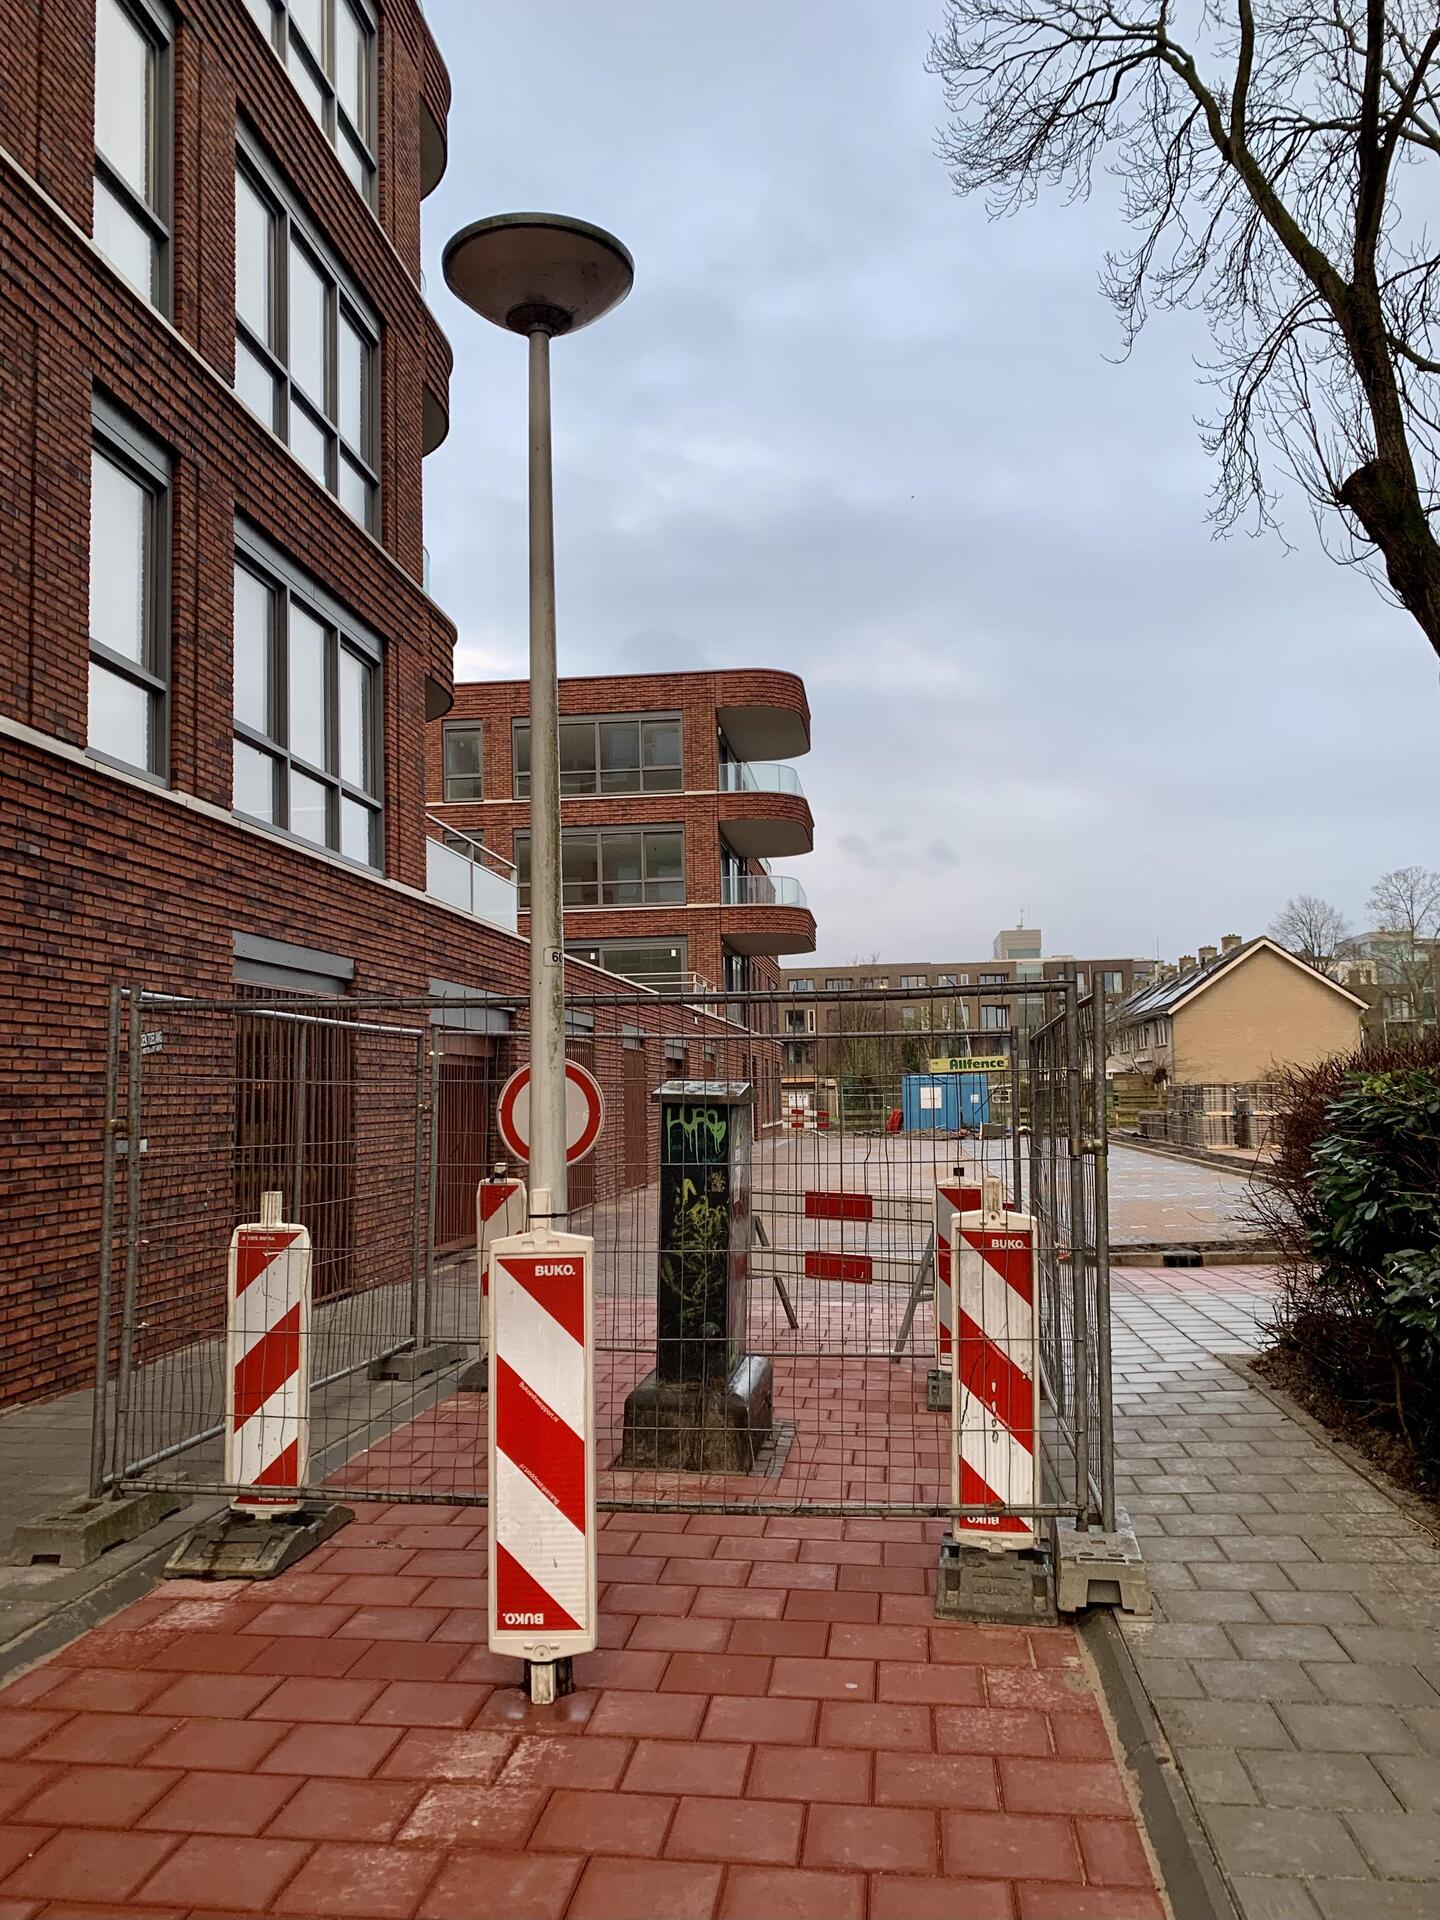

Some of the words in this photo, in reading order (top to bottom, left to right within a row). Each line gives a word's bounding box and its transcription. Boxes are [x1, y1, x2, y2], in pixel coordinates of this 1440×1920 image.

[949, 1058, 1004, 1070] Allfence
[991, 1238, 1027, 1249] BUKO.
[534, 1264, 576, 1277] BUKO.
[502, 1612, 544, 1625] BUKO.
